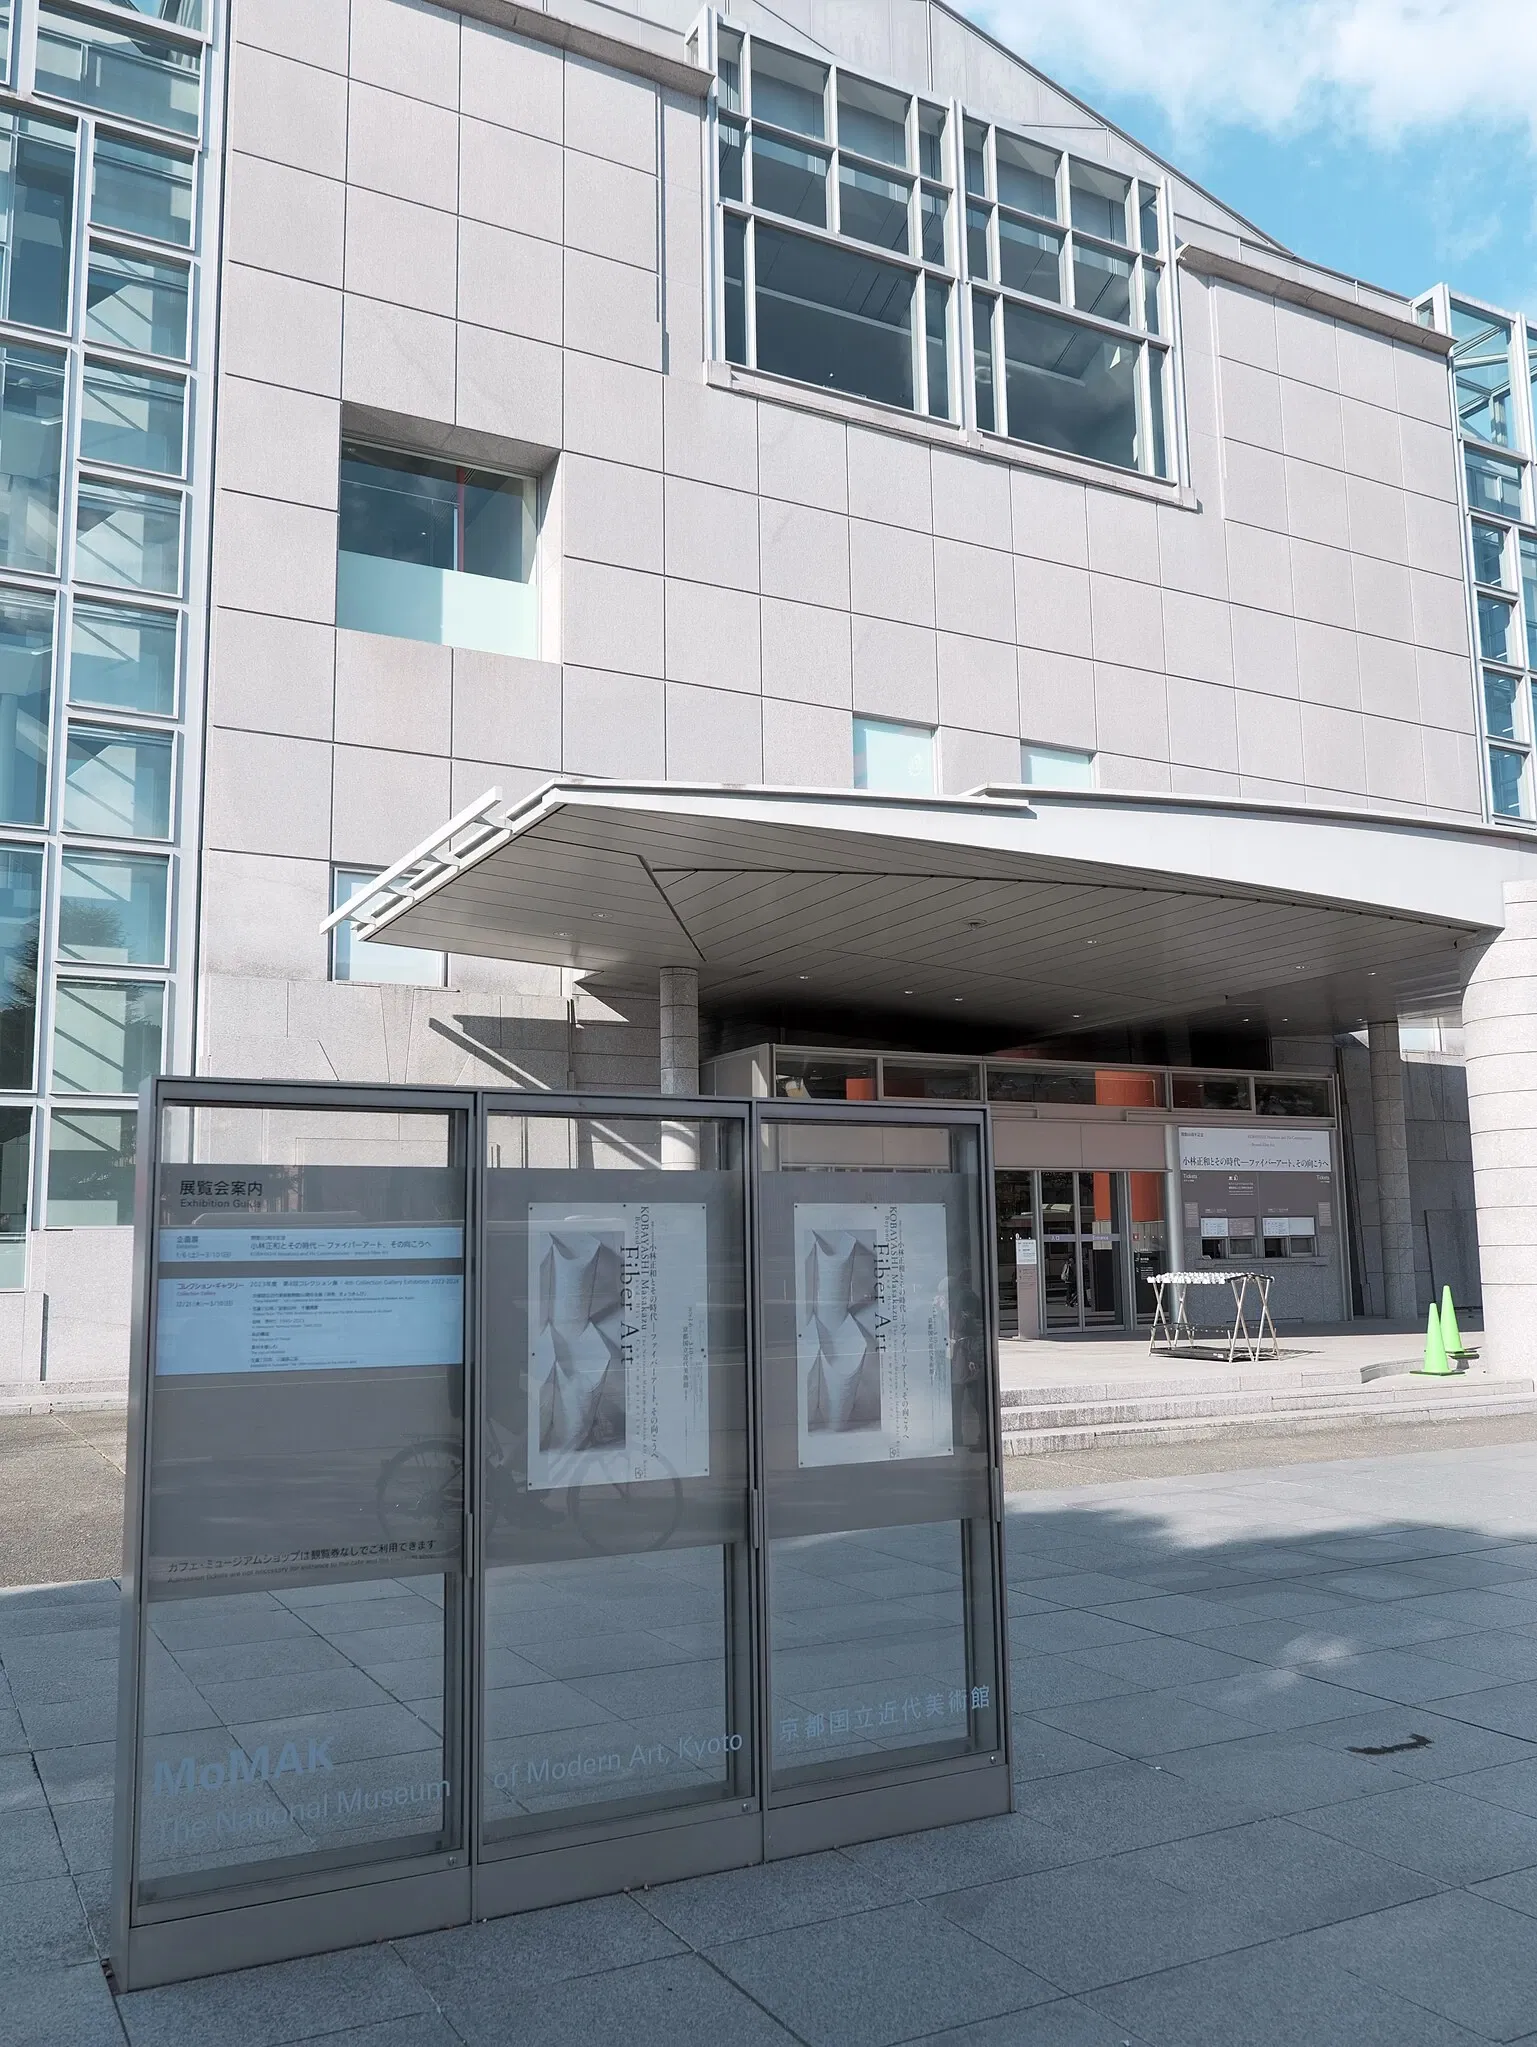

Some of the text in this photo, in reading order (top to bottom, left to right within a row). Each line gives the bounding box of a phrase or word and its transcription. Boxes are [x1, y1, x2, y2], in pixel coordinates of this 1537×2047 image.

[179, 1180, 263, 1197] 展覧会案内
[180, 1199, 230, 1208] Exhibition
[633, 1216, 641, 1245] Beyond
[641, 1206, 650, 1330] KOBAYASHI Masakazu
[889, 1206, 900, 1321] KOBAYASHI Masakazu
[620, 1245, 640, 1365] Fiber Art
[873, 1243, 892, 1353] Fiber Art
[168, 1540, 437, 1573] カフェ・ミュージアムショップは観覧券なしでご利用できます
[778, 1684, 991, 1743] 京都国立近代美術館
[153, 1735, 334, 1797] MoMAK
[494, 1732, 743, 1791] of Modern Art, Kyoto
[161, 1778, 451, 1844] The National Museum
